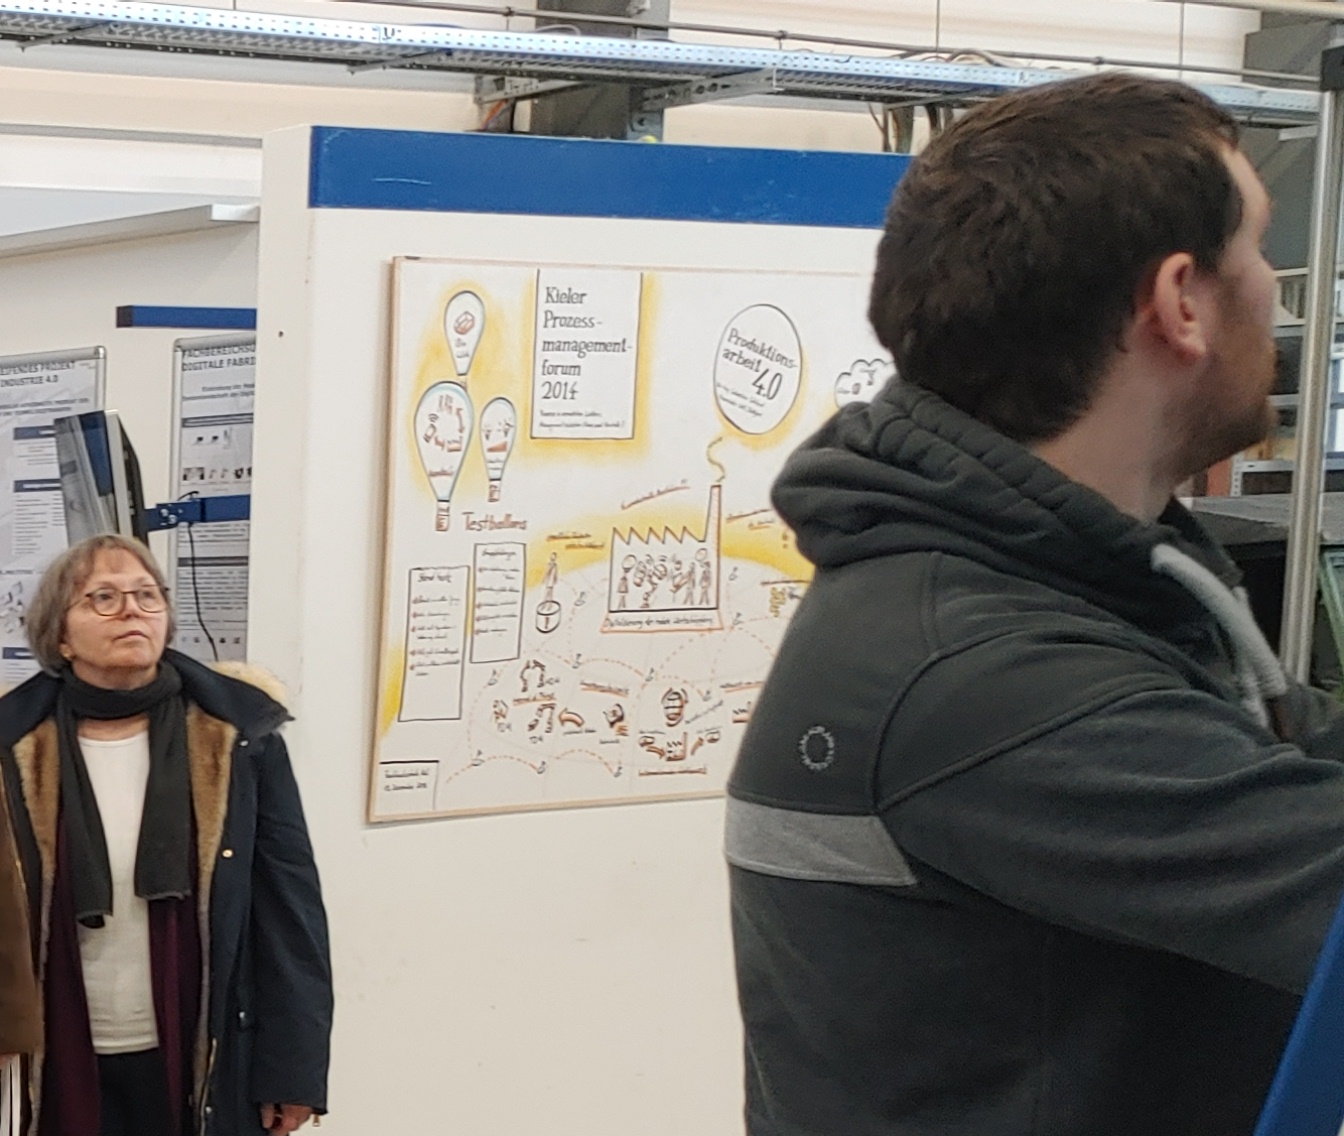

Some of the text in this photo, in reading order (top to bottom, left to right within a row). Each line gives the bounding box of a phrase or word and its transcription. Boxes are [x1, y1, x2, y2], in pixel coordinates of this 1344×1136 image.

[545, 286, 587, 304] Kieler
[543, 310, 603, 328] Prozess-
[542, 338, 633, 358] management-
[541, 359, 581, 376] forum
[722, 348, 762, 373] arbeit
[752, 368, 783, 401] 4.0
[0, 376, 44, 390] INDUSTRIE
